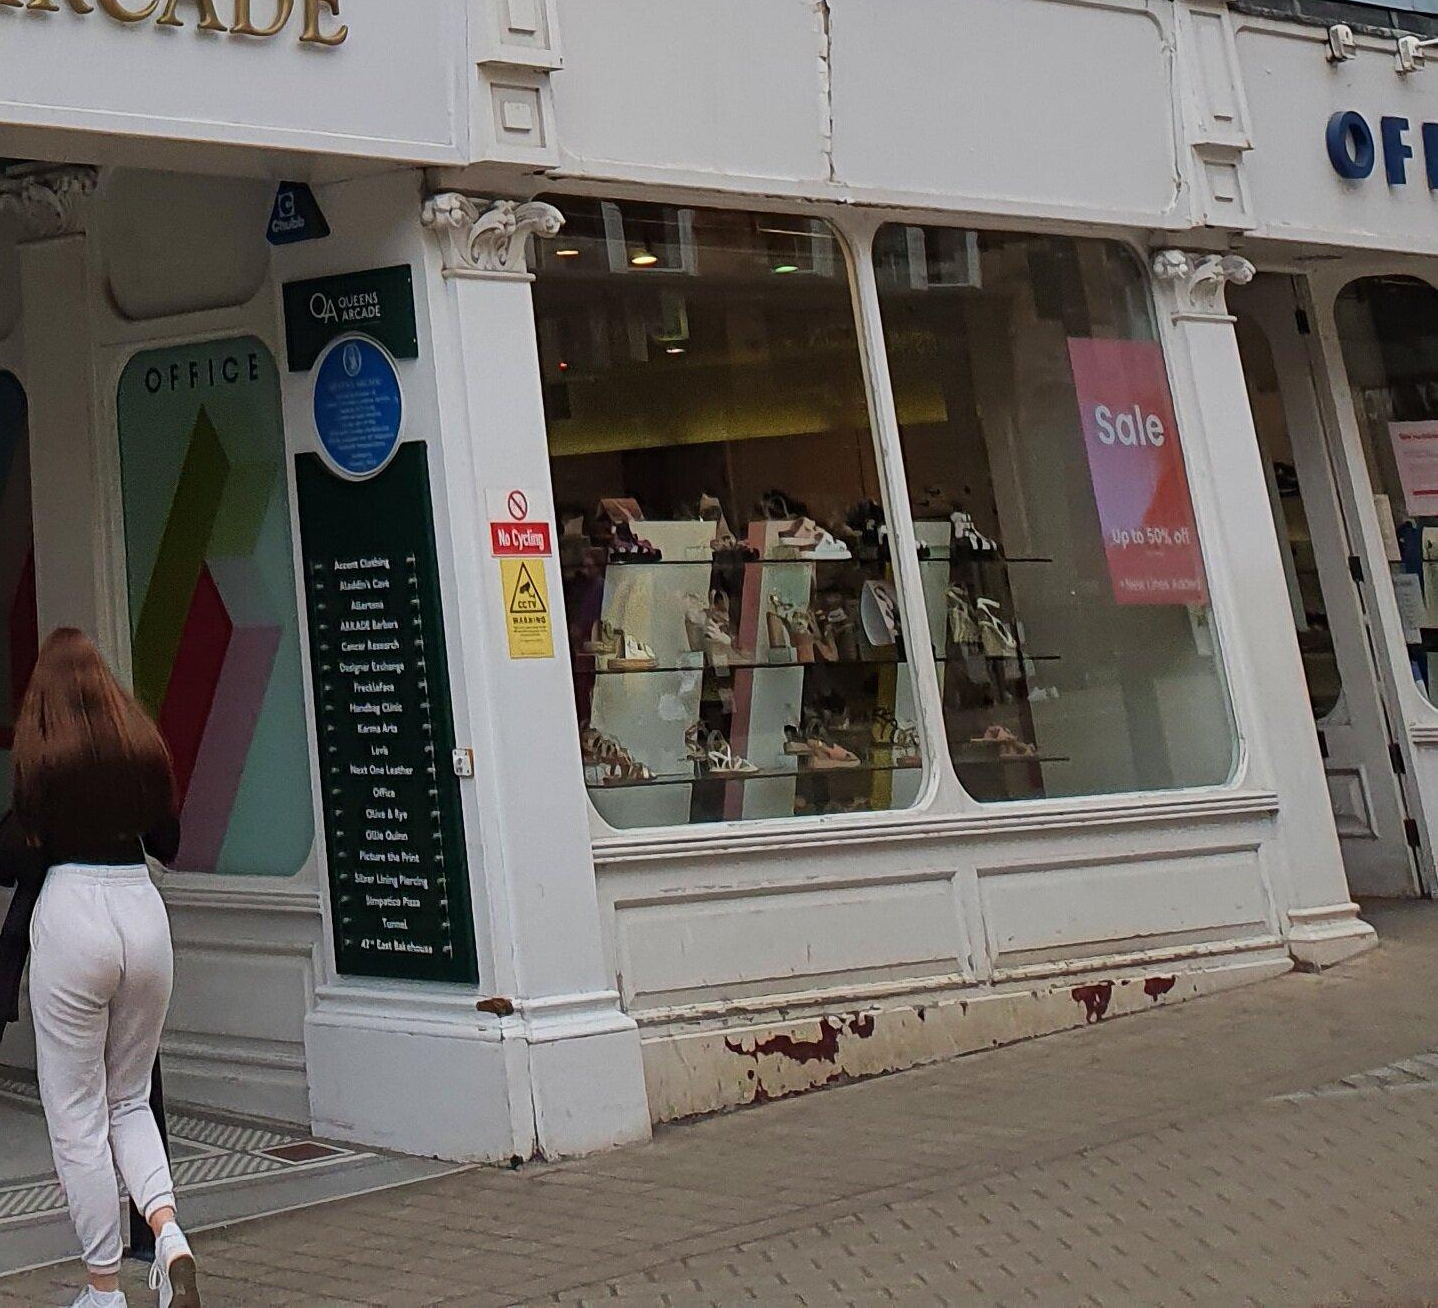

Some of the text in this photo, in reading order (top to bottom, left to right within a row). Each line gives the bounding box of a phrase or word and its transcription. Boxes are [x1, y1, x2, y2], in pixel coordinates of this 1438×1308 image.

[272, 215, 305, 233] Chubb
[338, 291, 379, 309] QUEENS
[342, 304, 381, 322] ARCADE
[144, 352, 260, 394] OFFICE
[1094, 404, 1165, 447] Sale
[497, 528, 545, 551] No Cycling
[1130, 530, 1145, 545] to
[1174, 528, 1191, 545] off
[518, 600, 537, 609] CCTV
[512, 616, 547, 624] WARNING
[382, 723, 398, 734] Arts
[385, 764, 414, 775] Leather
